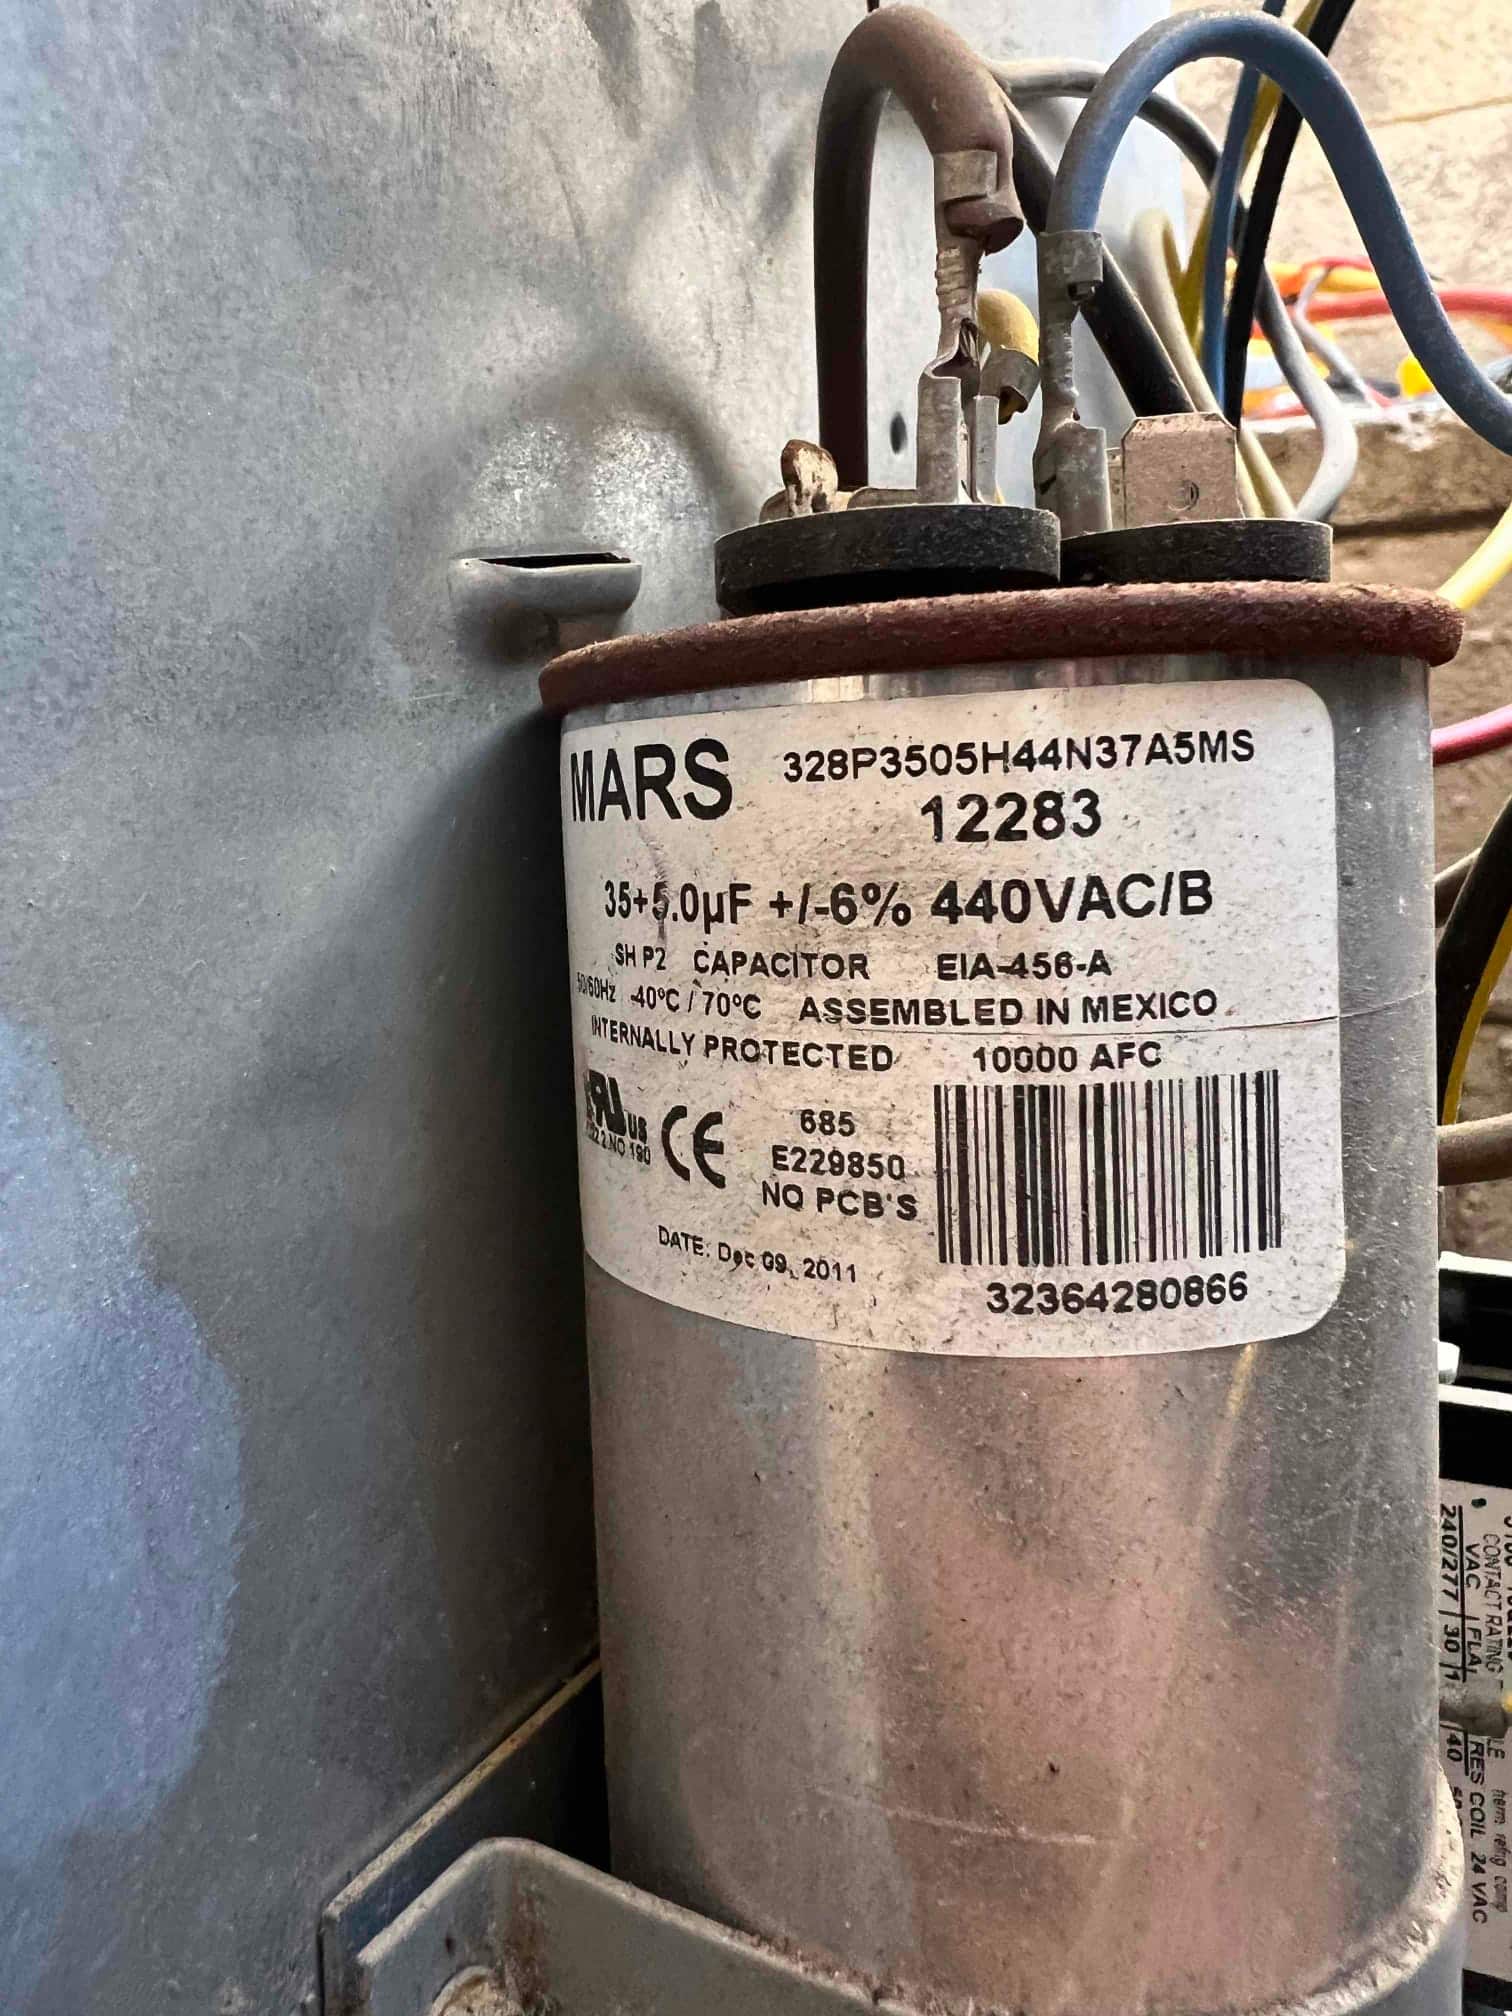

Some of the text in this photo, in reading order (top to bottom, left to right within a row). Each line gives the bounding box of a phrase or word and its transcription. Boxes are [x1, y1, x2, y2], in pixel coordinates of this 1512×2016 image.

[784, 729, 1256, 783] 328P3505H44N37A5MS
[571, 738, 733, 821] MARS
[921, 789, 1102, 843] 12283
[930, 869, 1214, 925] 440VAC/B
[615, 943, 870, 980] SH P2 CAPACITOR
[937, 949, 1113, 981] EIA-456-A
[799, 996, 1024, 1026] ASSEMBLED
[1037, 997, 1070, 1025] IN
[1082, 988, 1218, 1023] MEXICO
[591, 1014, 894, 1072] INTERNALLY PROTECTED
[972, 1040, 1162, 1073] 10000 AFC
[800, 1109, 856, 1137] 685
[661, 1104, 727, 1190] CE
[762, 1180, 918, 1221] NO PCB'S
[803, 1257, 856, 1283] 2011
[986, 1271, 1248, 1315] 32364280866
[1440, 1503, 1460, 1602] 240/277
[1465, 1543, 1482, 1666] VAC FLA
[1483, 1533, 1503, 1674] CONTACT RATING
[1443, 1623, 1461, 1654] 30
[1469, 1791, 1486, 1839] COIL
[1471, 1851, 1487, 1875] 24
[1471, 1881, 1488, 1924] VAC
